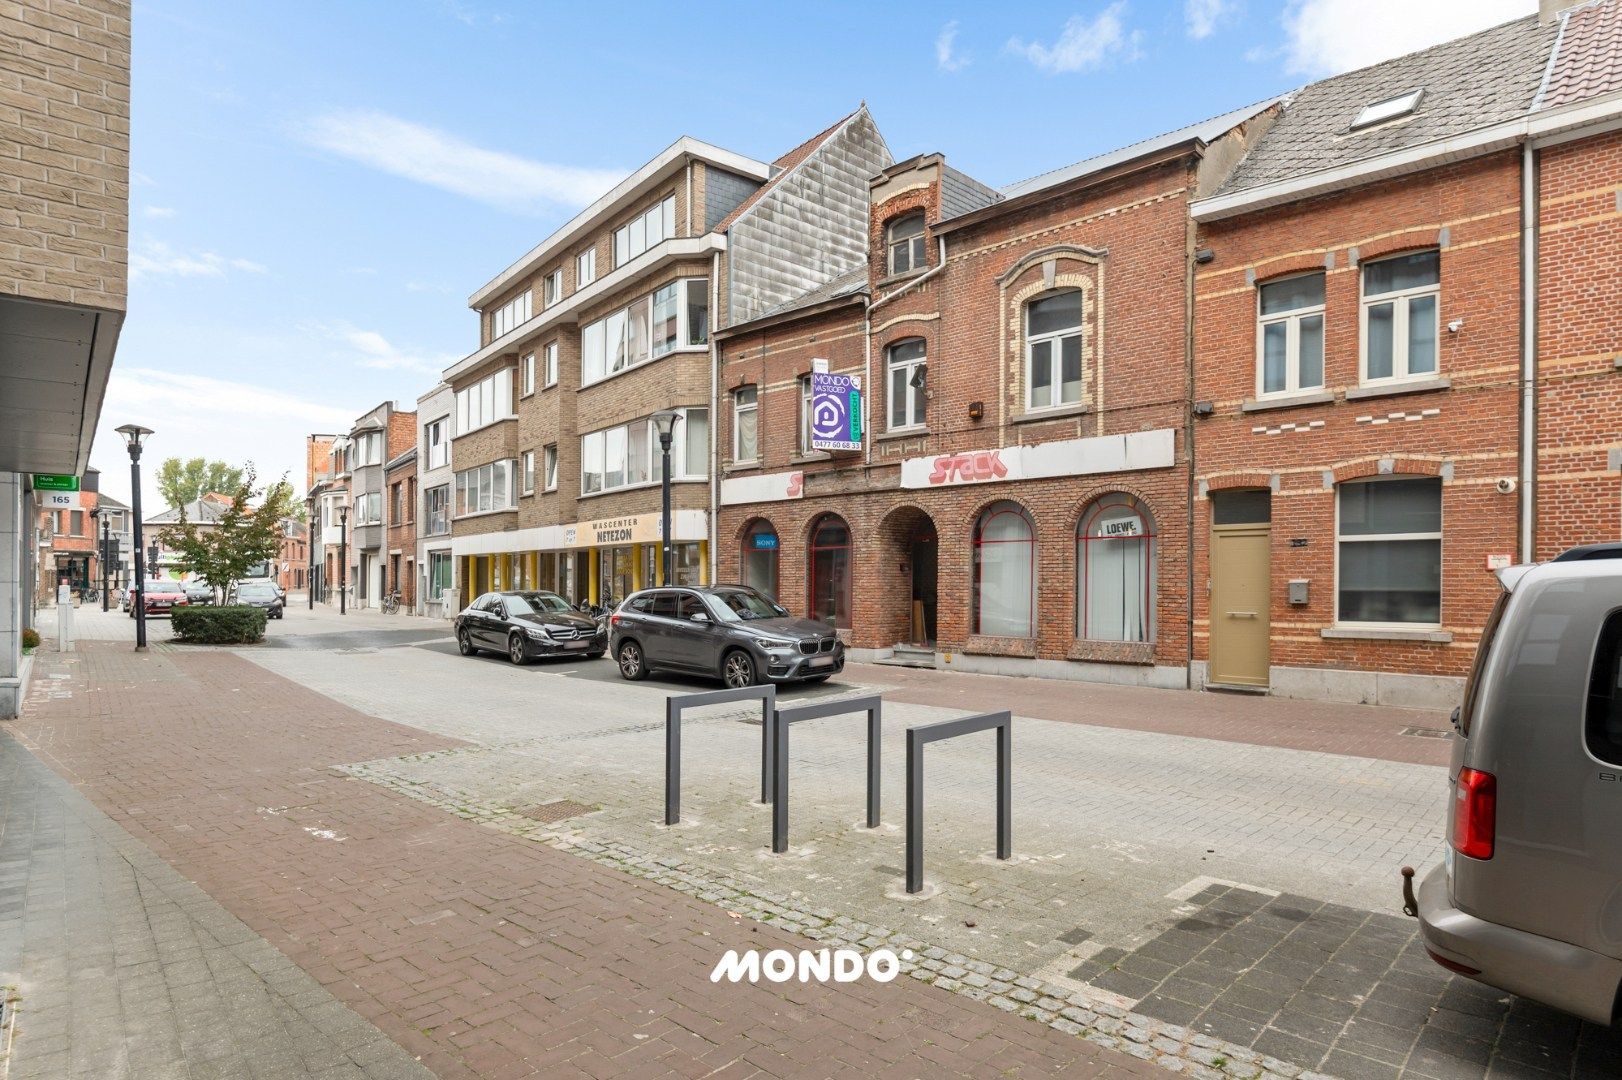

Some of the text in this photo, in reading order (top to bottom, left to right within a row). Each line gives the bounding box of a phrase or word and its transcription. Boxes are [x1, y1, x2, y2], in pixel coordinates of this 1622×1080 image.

[814, 374, 850, 386] MONDO
[815, 385, 846, 394] VASTGOED
[597, 528, 632, 542] NETEZON
